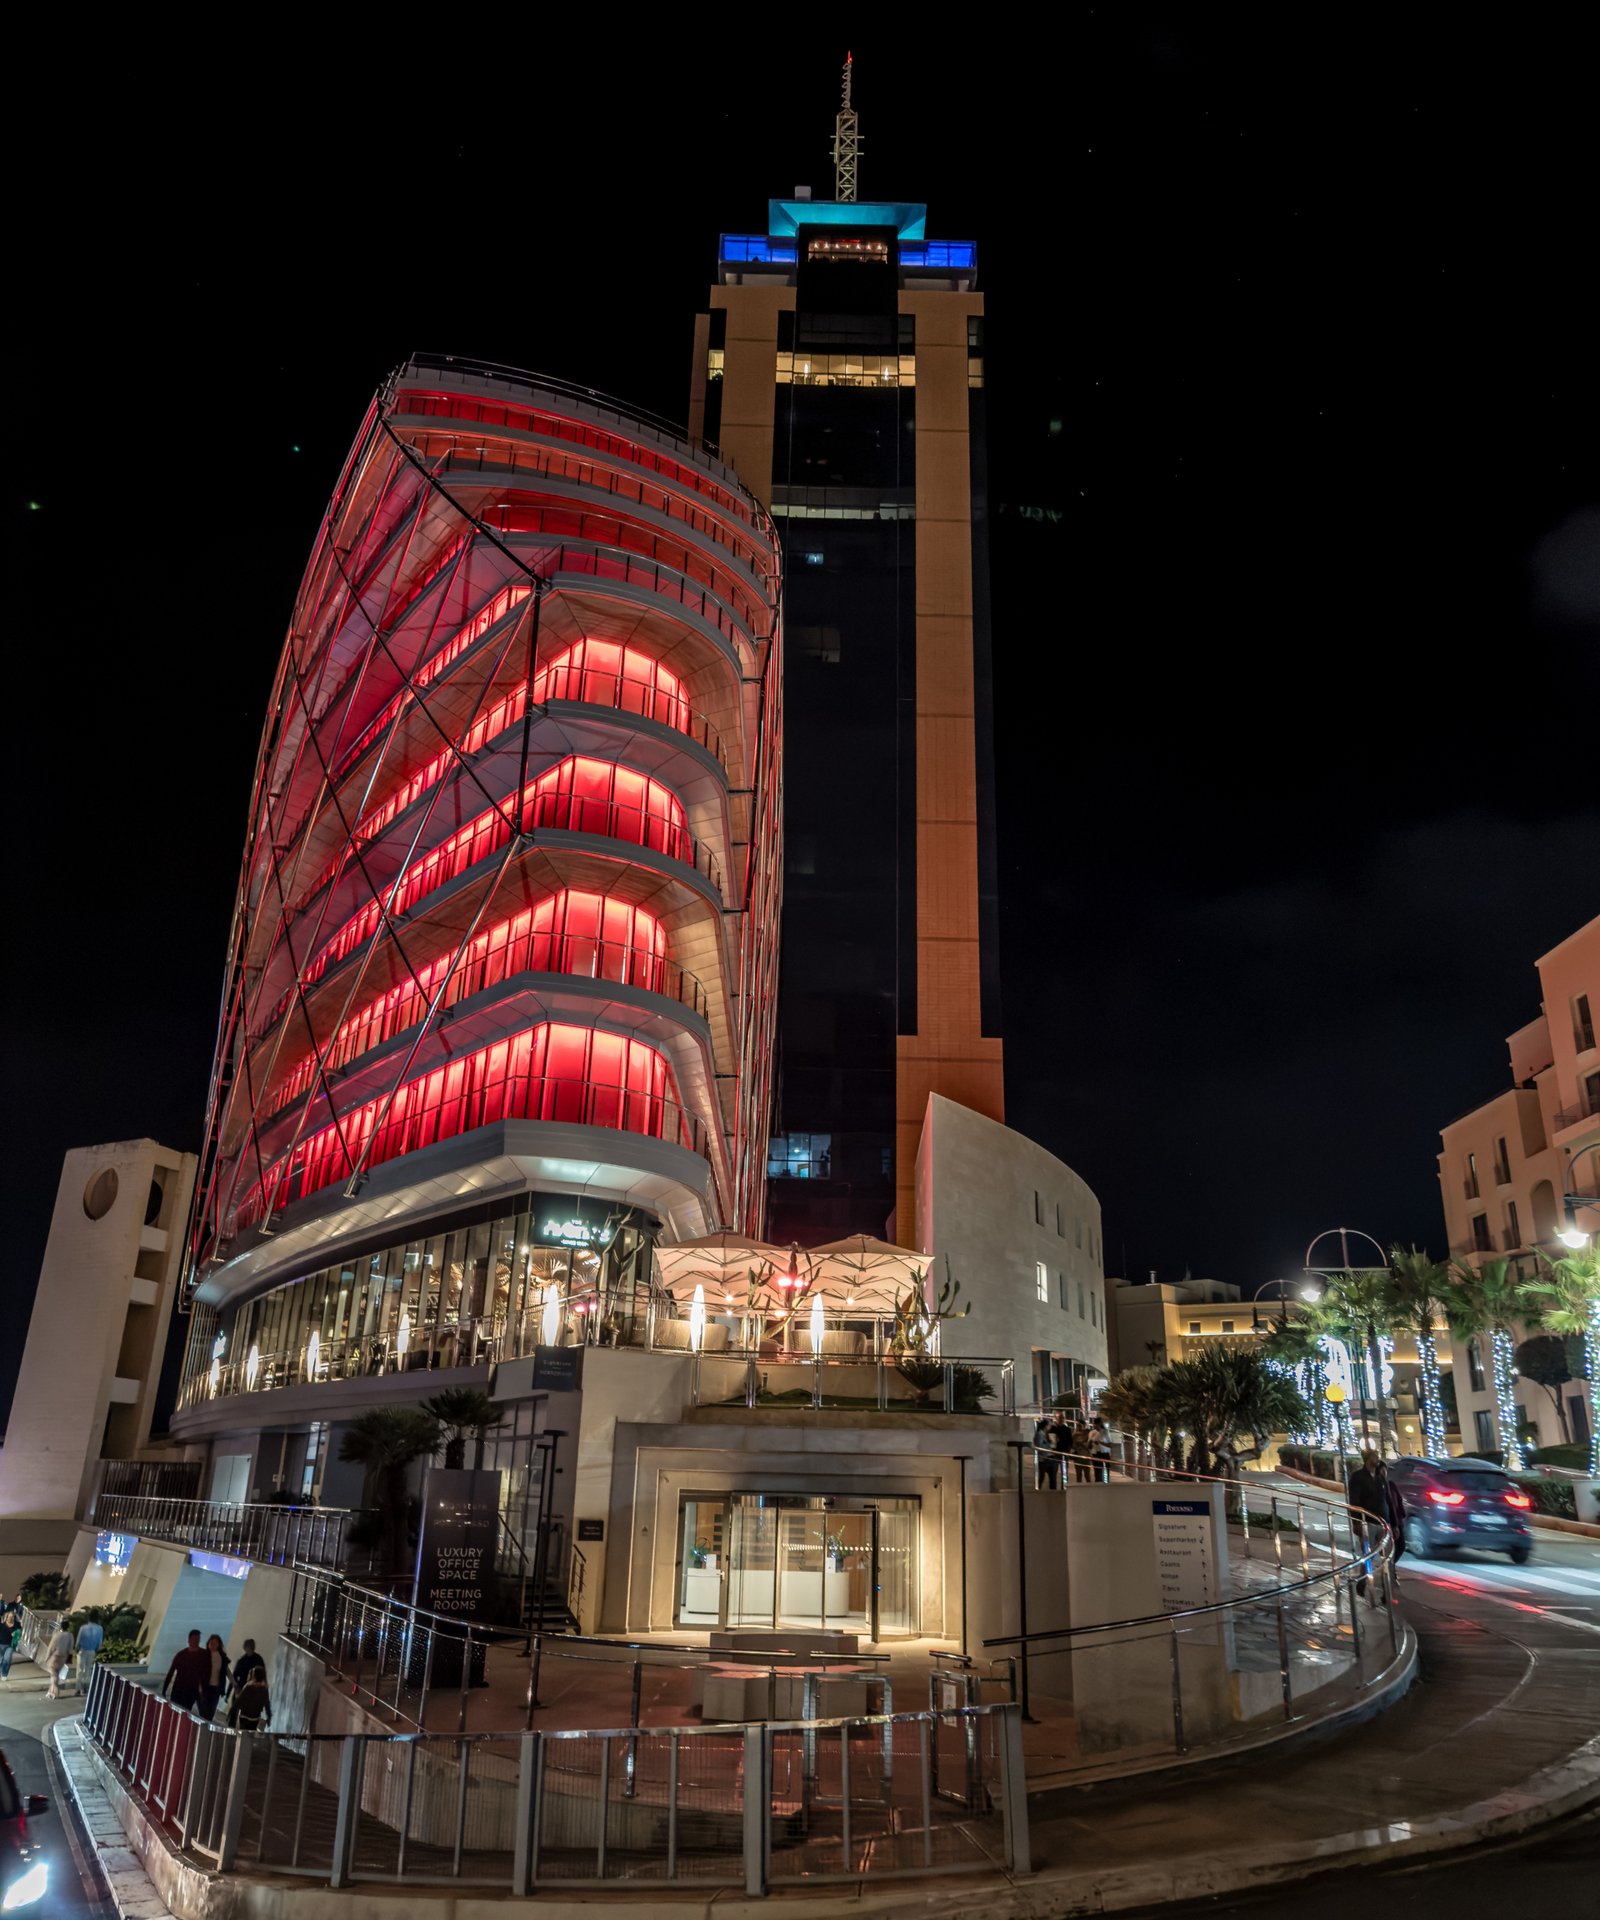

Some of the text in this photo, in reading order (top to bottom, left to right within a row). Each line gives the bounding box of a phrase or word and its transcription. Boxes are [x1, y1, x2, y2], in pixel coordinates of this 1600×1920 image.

[1158, 1536, 1197, 1544] Supermarket
[436, 1547, 484, 1558] LUXURY
[438, 1558, 481, 1569] OFFICE
[438, 1569, 477, 1580] SPACE
[429, 1588, 482, 1600] MEETING
[433, 1600, 477, 1611] ROOMS
